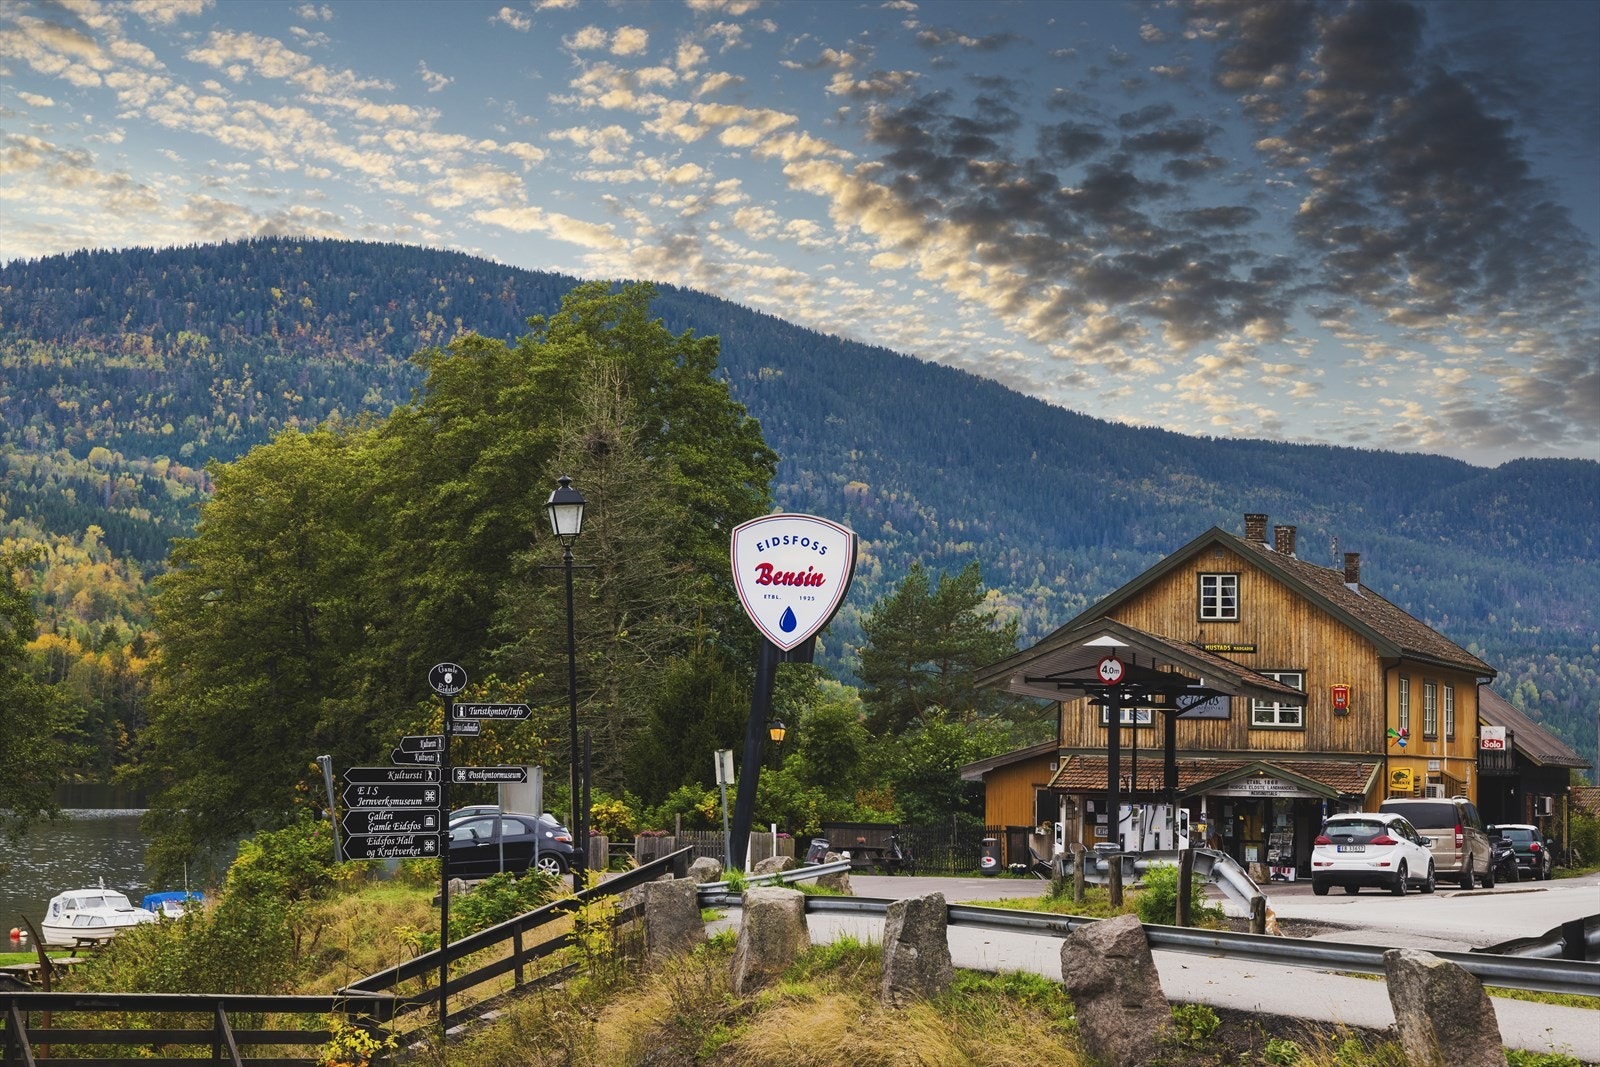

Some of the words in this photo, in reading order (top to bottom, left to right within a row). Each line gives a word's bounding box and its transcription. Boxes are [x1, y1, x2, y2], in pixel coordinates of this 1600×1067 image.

[755, 535, 828, 555] EIDSFOSS
[755, 562, 826, 587] Bensin
[437, 665, 458, 674] Gamle
[437, 682, 459, 692] Eidsfos
[468, 706, 524, 718] Turistkontor/Info
[1483, 740, 1502, 748] Solo
[387, 770, 424, 781] Kultursti
[468, 770, 522, 781] Postkontormuseum
[356, 796, 423, 807] Jernverksmuseum
[367, 810, 394, 823] Galleri
[367, 821, 392, 834] Gamle
[392, 821, 422, 833] Eidsfos
[366, 836, 395, 847] Eidsfos
[396, 835, 416, 845] Hall
[366, 849, 376, 858] og
[377, 845, 421, 858] Kraftverket
